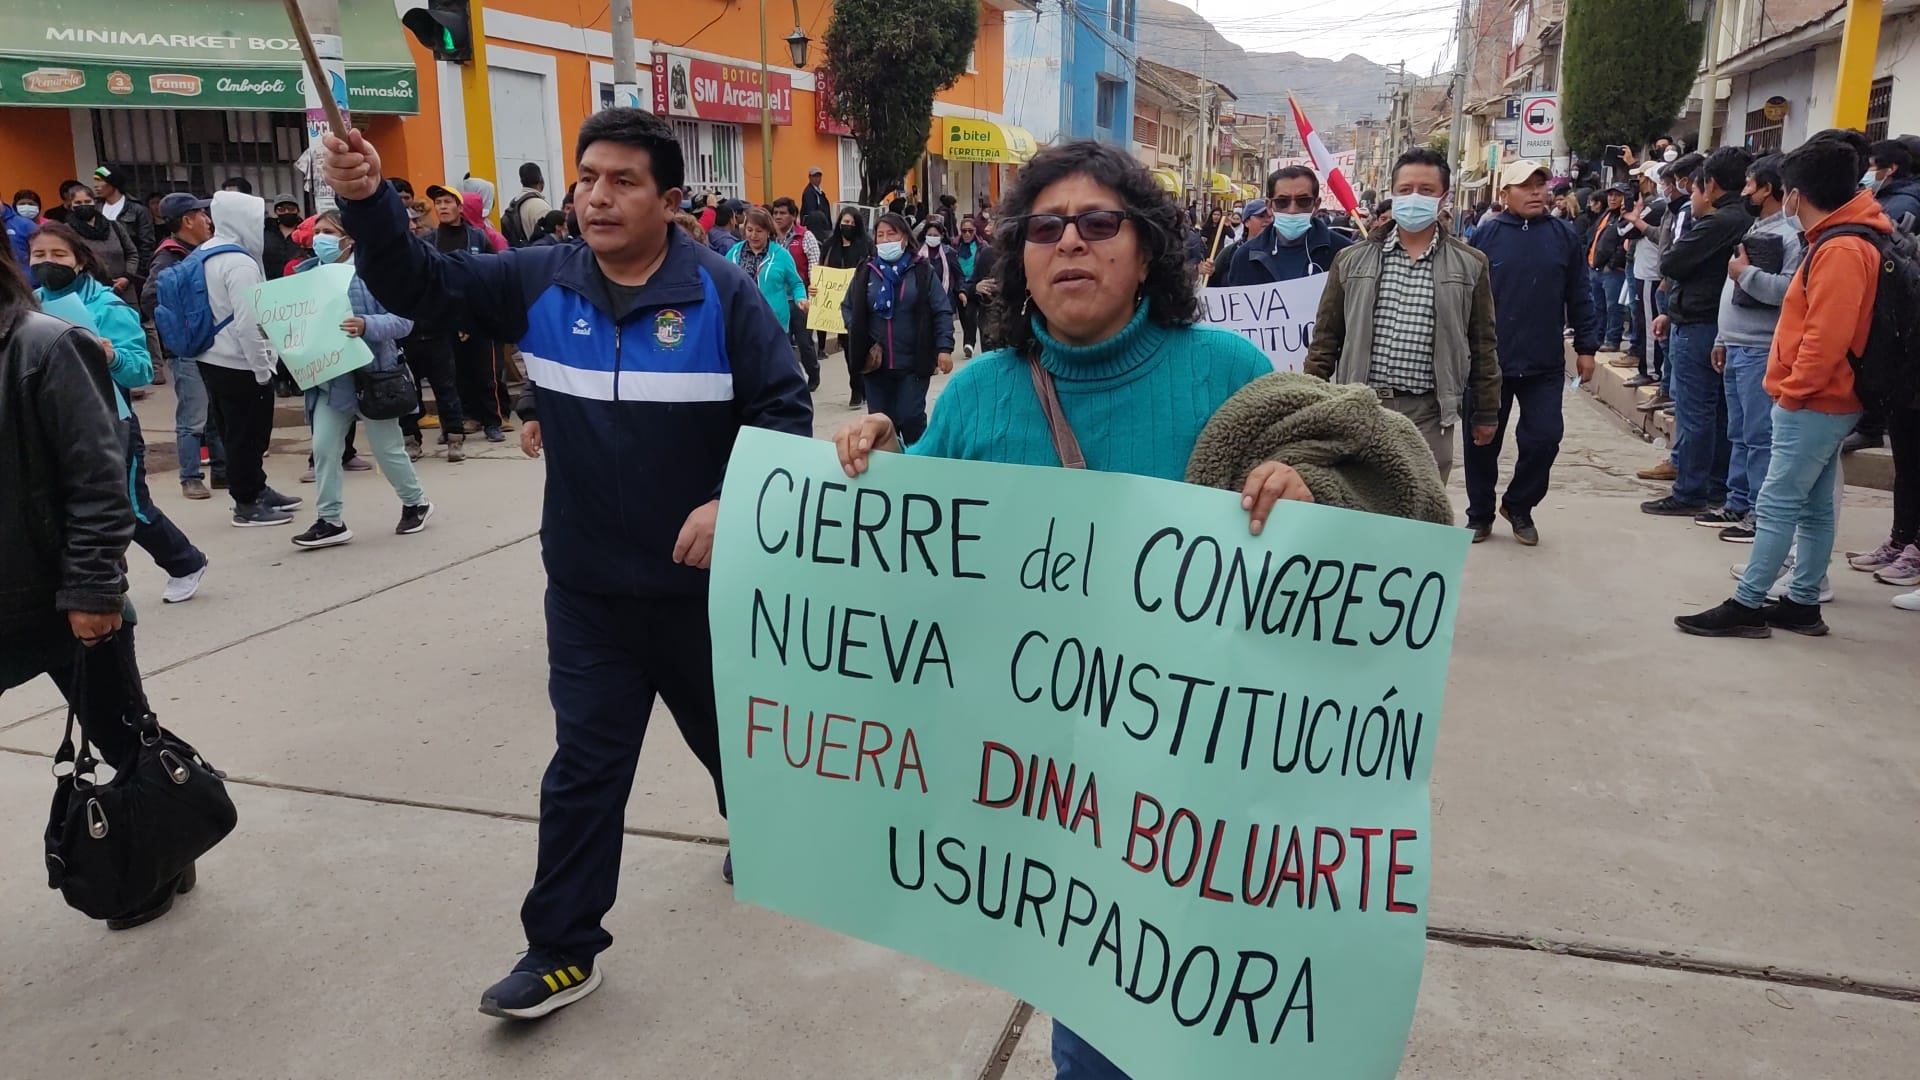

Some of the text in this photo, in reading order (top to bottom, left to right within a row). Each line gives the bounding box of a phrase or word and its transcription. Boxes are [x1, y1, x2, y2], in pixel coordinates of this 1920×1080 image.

[46, 27, 302, 50] MINIMARKET BOZ
[29, 73, 81, 88] Pomarola
[115, 77, 124, 87] 3
[156, 78, 195, 91] Fanny
[216, 78, 286, 95] Ambrosoli
[350, 85, 413, 98] mimaskot
[655, 54, 666, 113] BOTICA
[694, 77, 718, 104] SM
[723, 83, 781, 111] Arcanel
[817, 72, 827, 131] BOTICA
[963, 130, 991, 142] bitel
[283, 320, 307, 350] del
[756, 467, 1446, 650] CIERRE del CONGRESO
[752, 587, 1423, 781] NUEVA CONSTITUCIÓN
[746, 695, 1418, 914] FUERA DINA BOLUARTE
[888, 825, 1314, 1045] USURPADORA
